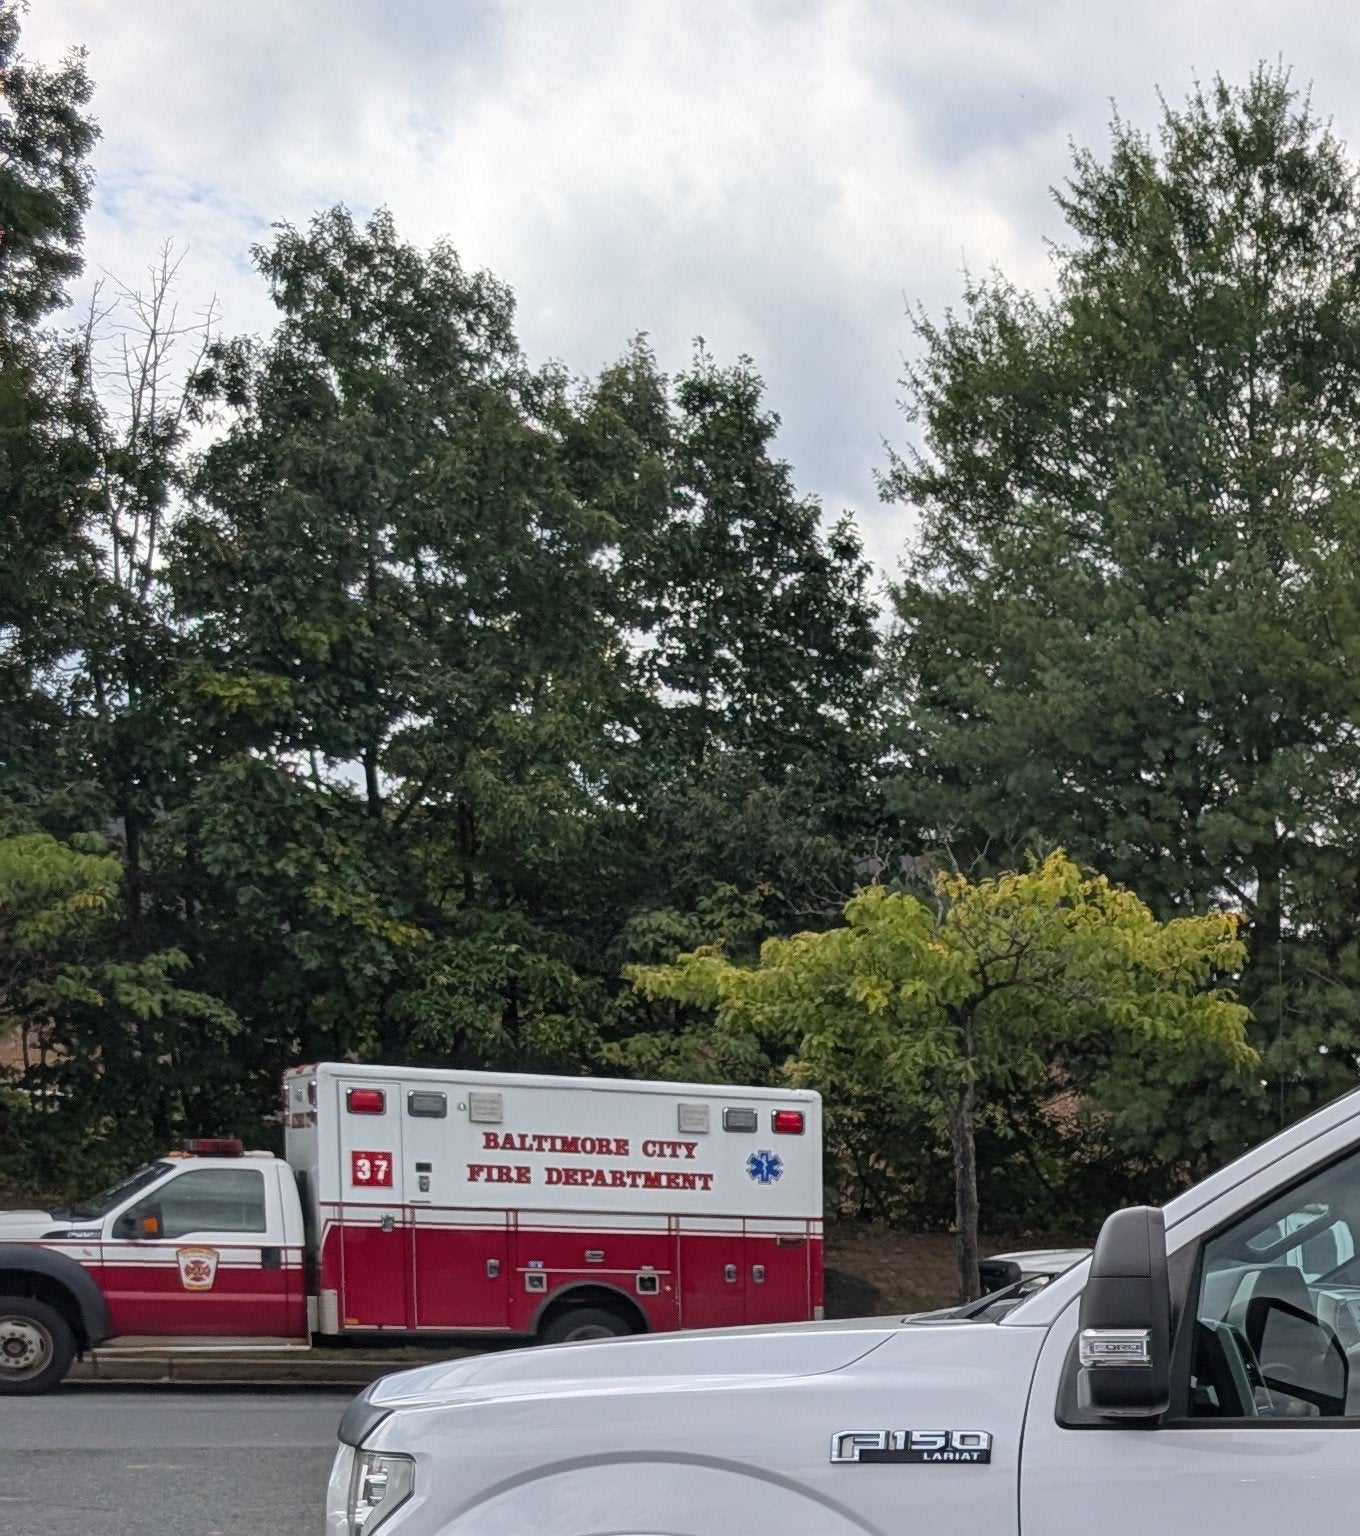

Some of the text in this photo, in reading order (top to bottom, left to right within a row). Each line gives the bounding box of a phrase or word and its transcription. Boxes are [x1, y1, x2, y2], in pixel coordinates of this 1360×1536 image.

[483, 1131, 698, 1159] BALTIMORE CITY
[355, 1159, 388, 1180] 37
[467, 1163, 713, 1191] FIRE DEPARTMENT
[923, 1451, 981, 1461] LARIAT
